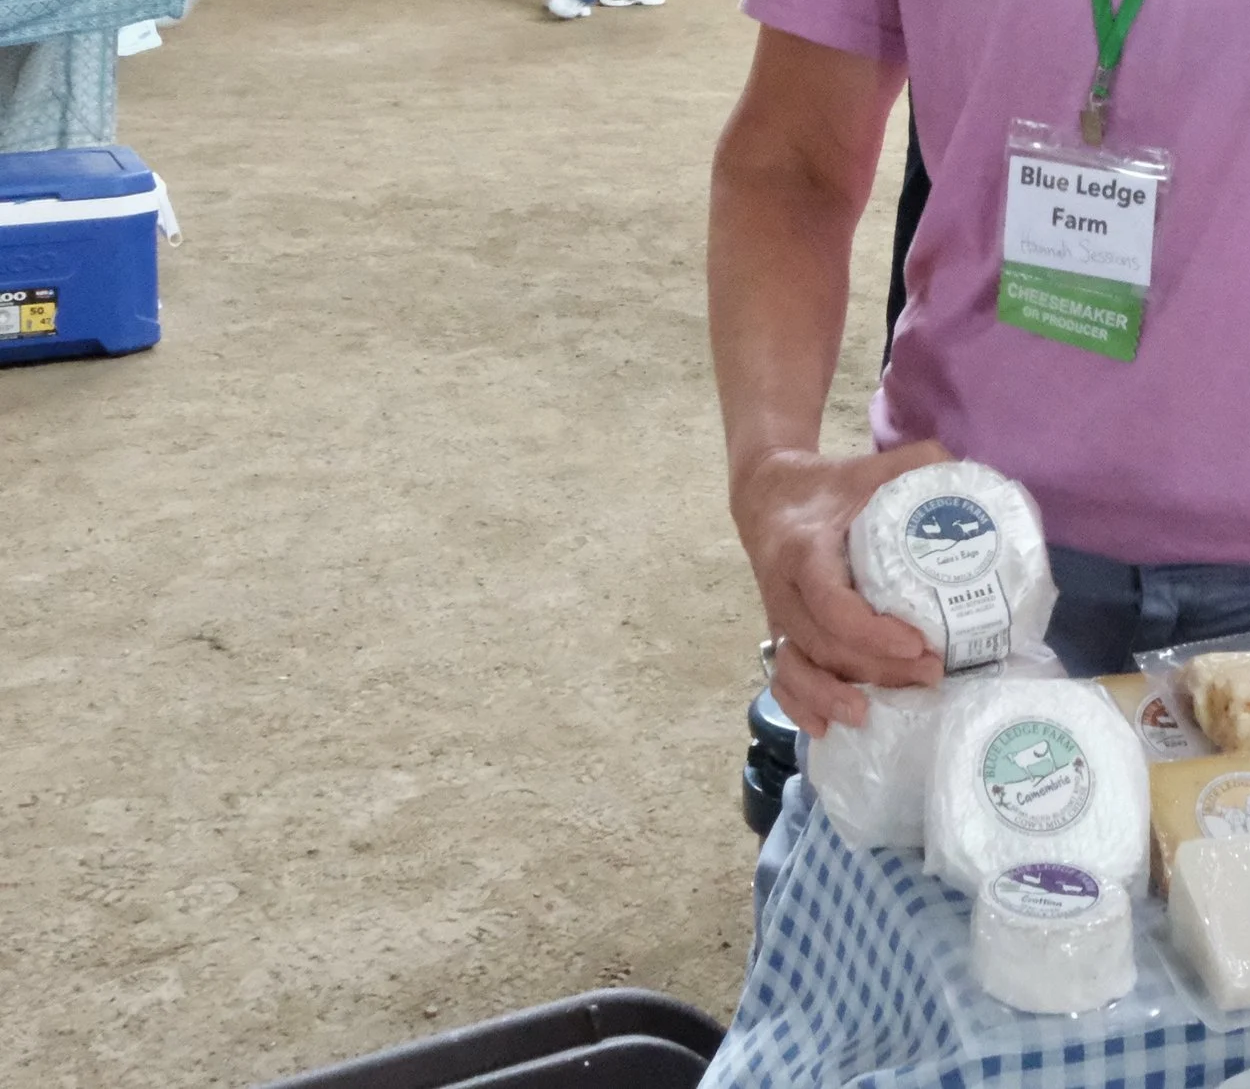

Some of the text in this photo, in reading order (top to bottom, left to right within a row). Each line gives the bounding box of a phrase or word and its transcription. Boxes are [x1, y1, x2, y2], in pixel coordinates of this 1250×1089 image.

[1020, 165, 1146, 209] Blue Ledge
[1052, 207, 1107, 235] Farm
[1007, 281, 1128, 331] CHEESEMAKER
[1022, 305, 1109, 342] OR PRODUCER
[924, 496, 961, 513] LEDGE
[962, 501, 988, 525] FARM
[948, 583, 994, 606] mini
[985, 724, 1076, 778] BLUE LEDGE FARM
[1016, 775, 1072, 806] Camembrie
